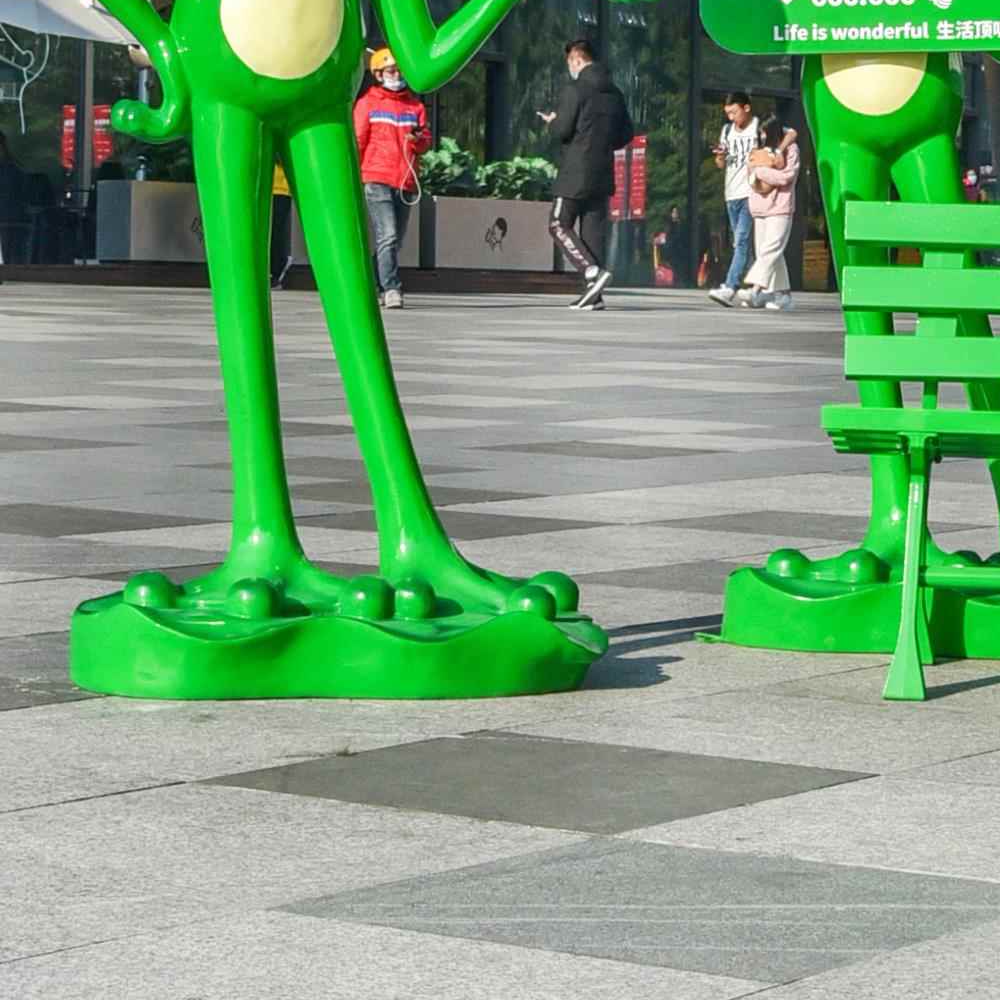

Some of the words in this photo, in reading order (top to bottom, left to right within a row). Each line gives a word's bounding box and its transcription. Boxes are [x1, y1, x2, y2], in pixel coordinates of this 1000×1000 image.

[773, 23, 809, 41] Life
[811, 23, 828, 41] is
[830, 21, 930, 41] wonderful
